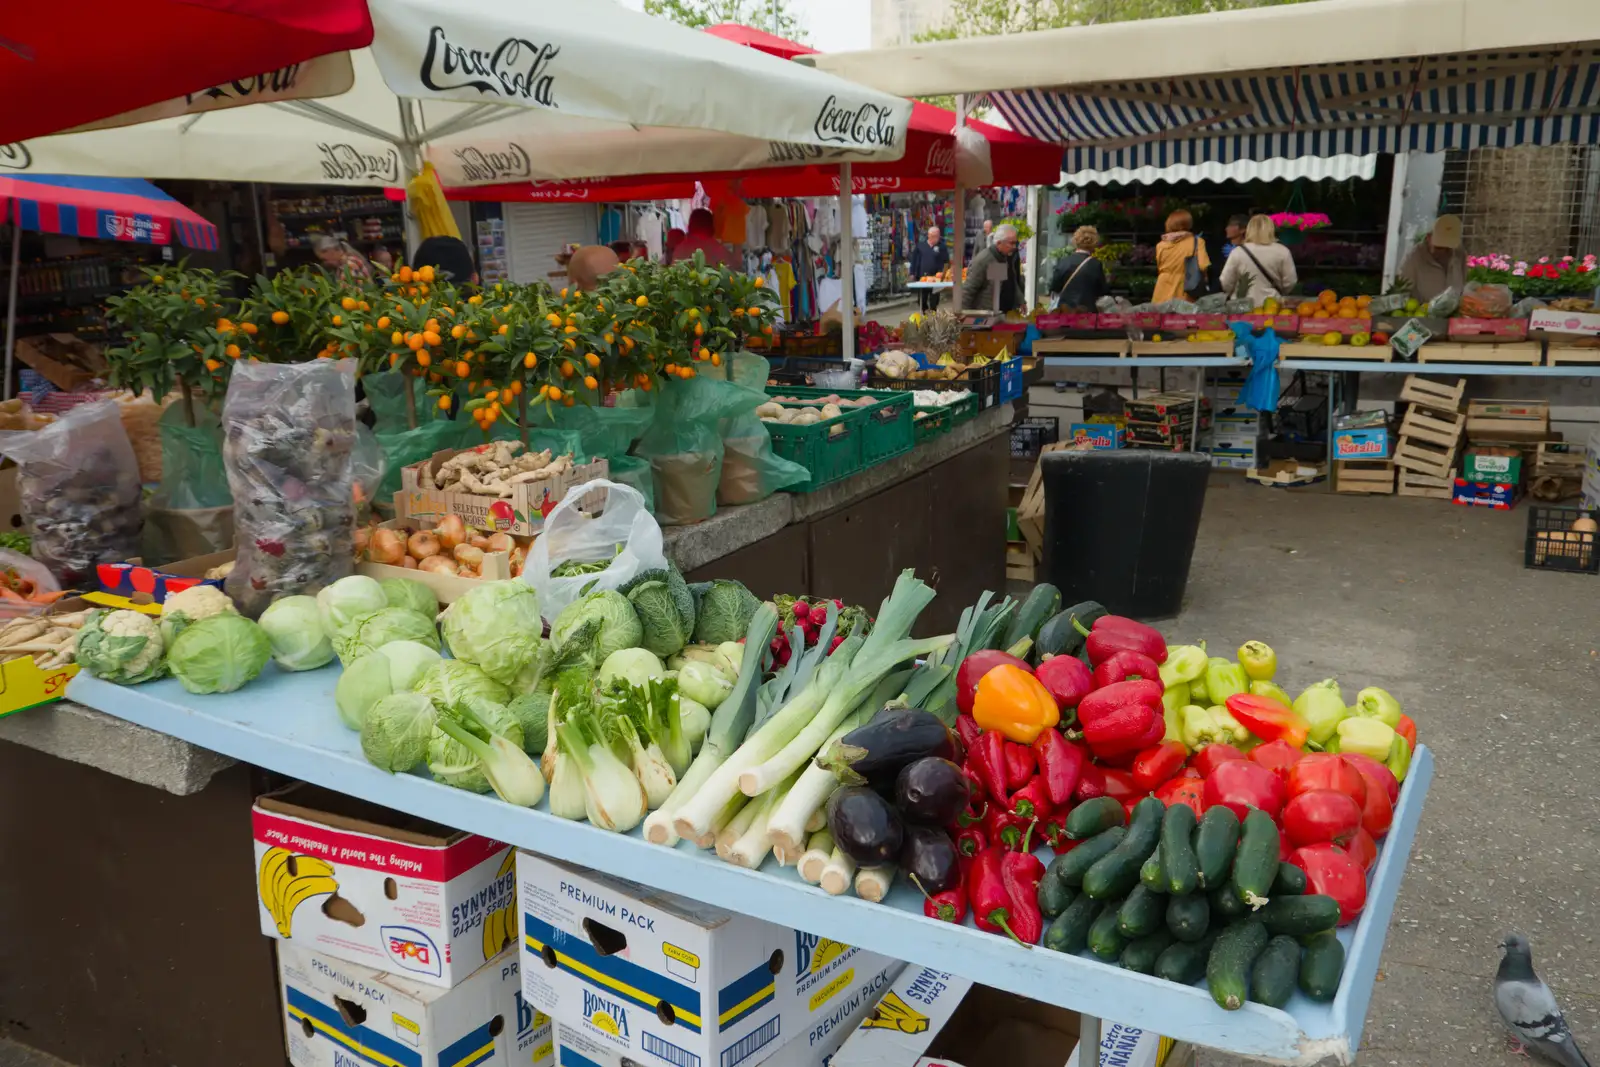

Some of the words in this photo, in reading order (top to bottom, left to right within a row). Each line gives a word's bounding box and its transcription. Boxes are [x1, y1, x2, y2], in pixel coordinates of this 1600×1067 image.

[420, 26, 560, 108] Coca-Cola
[814, 95, 897, 147] Coca-Cola
[452, 503, 489, 516] SELECTED
[264, 829, 289, 844] Place
[290, 835, 329, 854] Healthier
[331, 846, 338, 856] A
[340, 847, 367, 862] World
[368, 852, 387, 867] The
[389, 853, 423, 872] Making
[451, 871, 513, 925] BANANAS
[486, 891, 513, 915] Class
[560, 881, 616, 916] PREMIUM
[621, 908, 655, 933] PACK
[453, 911, 482, 938] Extra
[311, 959, 355, 990] PREMIUM
[358, 982, 386, 1005] PACK
[796, 966, 831, 997] PREMIUM
[833, 946, 861, 970] BANAN
[922, 981, 947, 1005] Extra
[582, 988, 629, 1037] BONITA
[809, 995, 860, 1047] PREMIUM
[862, 968, 889, 1000] PACK
[606, 1032, 630, 1049] BANANAS
[1100, 1023, 1122, 1050] Extra
[1108, 1026, 1143, 1067] NANAS
